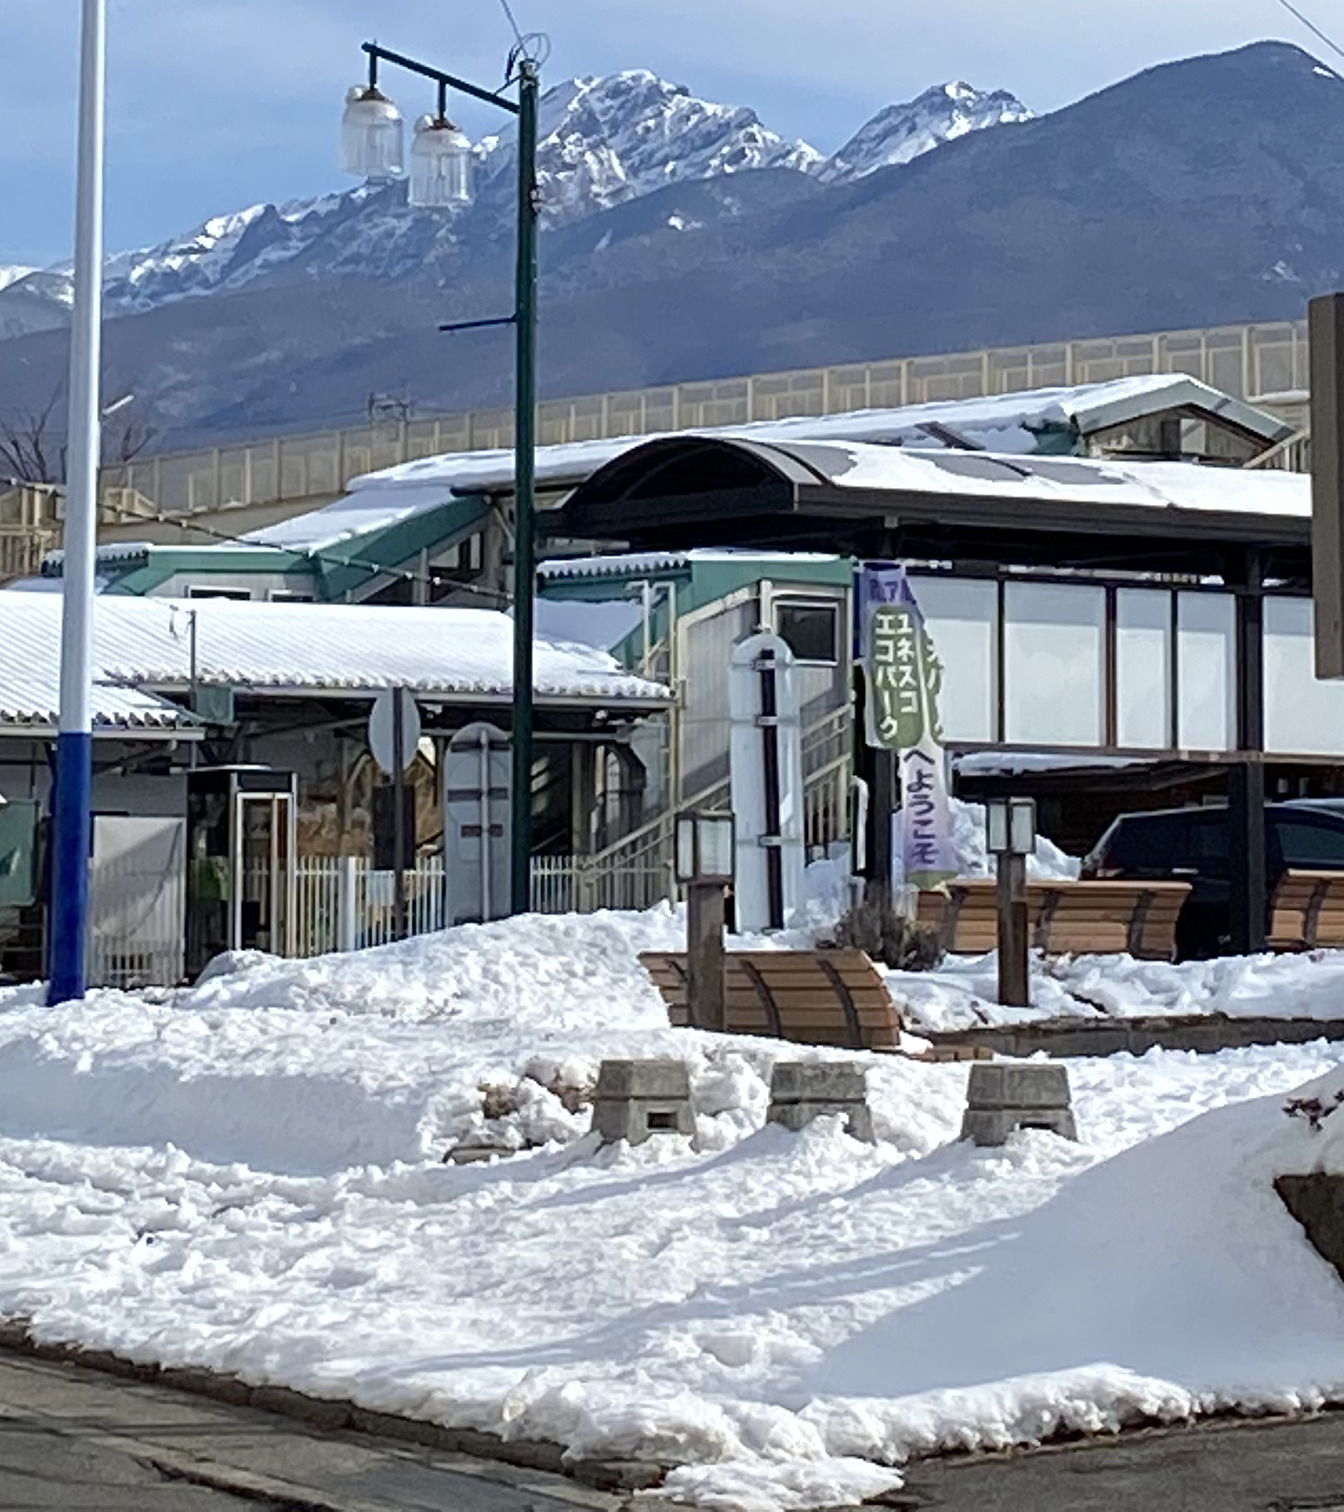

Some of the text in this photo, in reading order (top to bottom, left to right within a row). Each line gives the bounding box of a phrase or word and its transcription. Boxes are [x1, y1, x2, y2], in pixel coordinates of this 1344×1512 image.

[874, 613, 899, 740] エコパーク
[896, 613, 918, 714] ユネスコ
[903, 748, 940, 866] へようこそ
